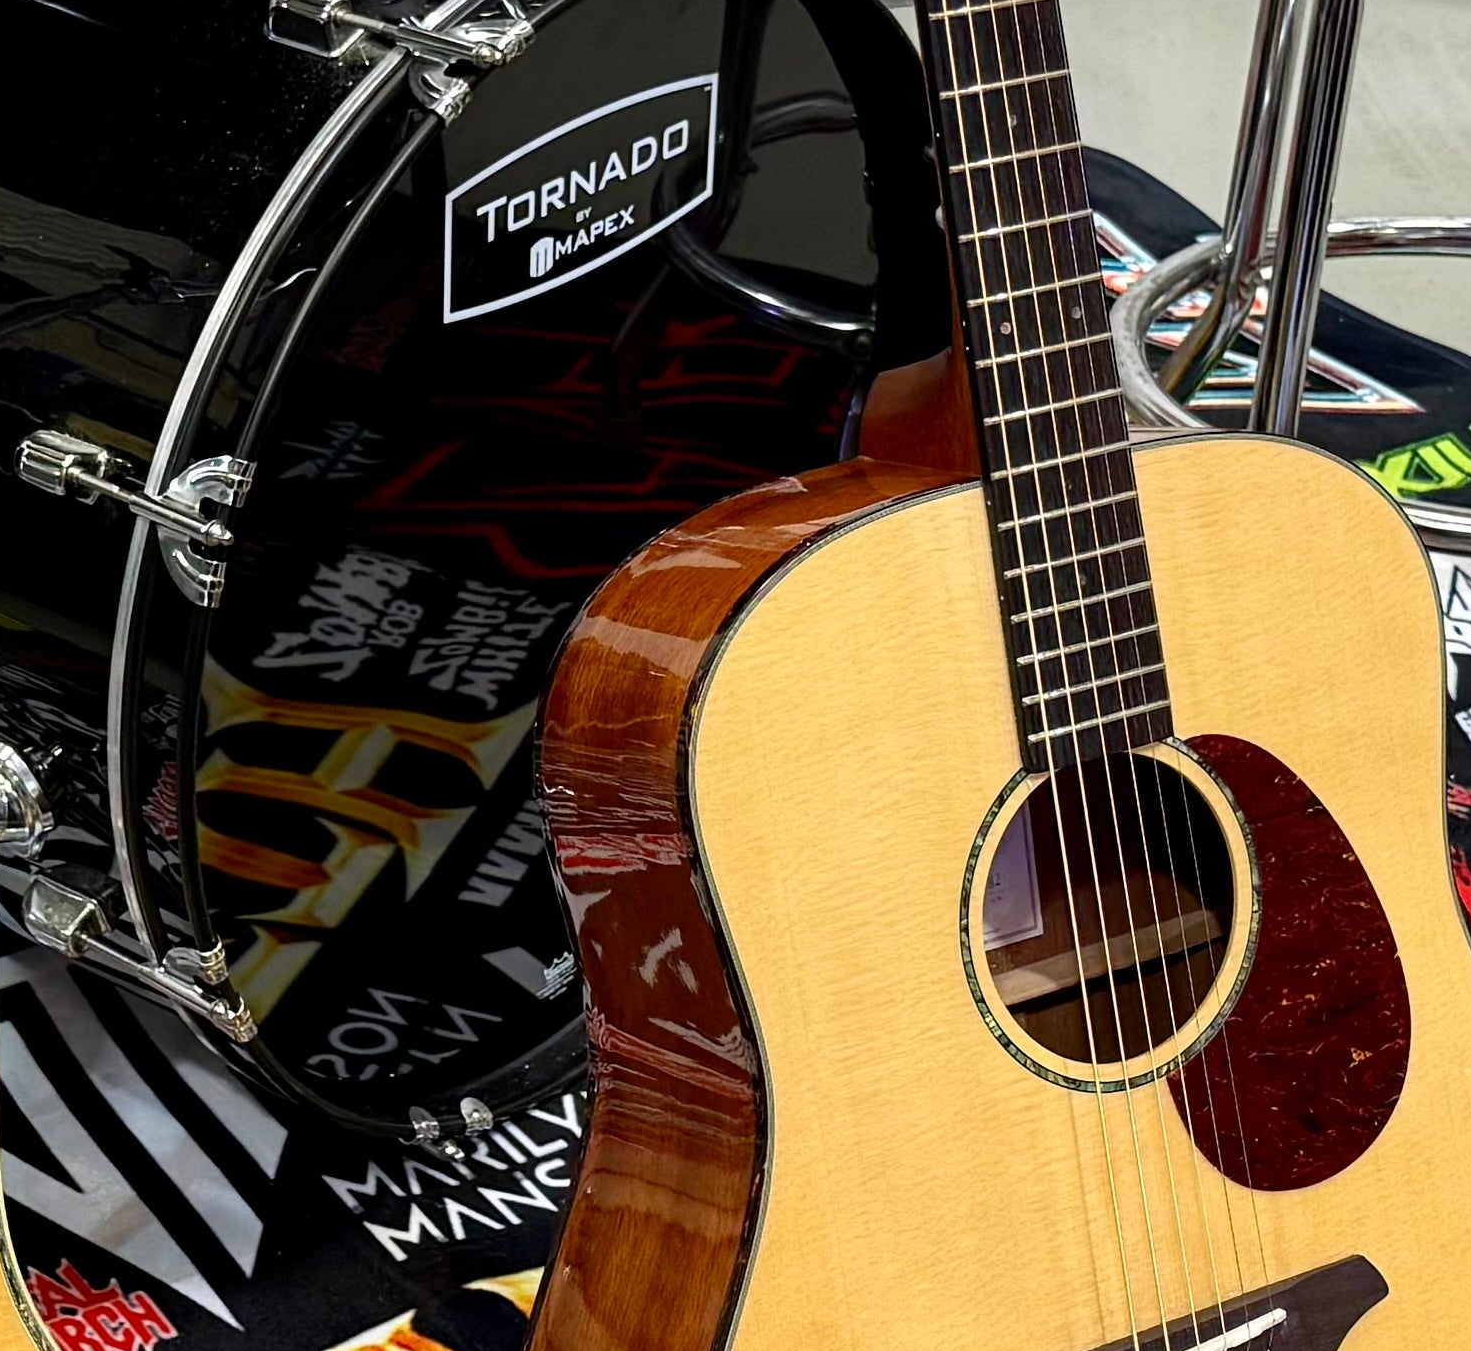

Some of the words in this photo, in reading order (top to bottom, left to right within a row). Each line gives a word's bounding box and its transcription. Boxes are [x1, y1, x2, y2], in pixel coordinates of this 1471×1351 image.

[477, 119, 690, 243] TORNADO
[555, 204, 635, 260] MAPEX
[576, 206, 593, 224] BY
[322, 1091, 587, 1215] MARILY
[26, 1258, 123, 1322] AL
